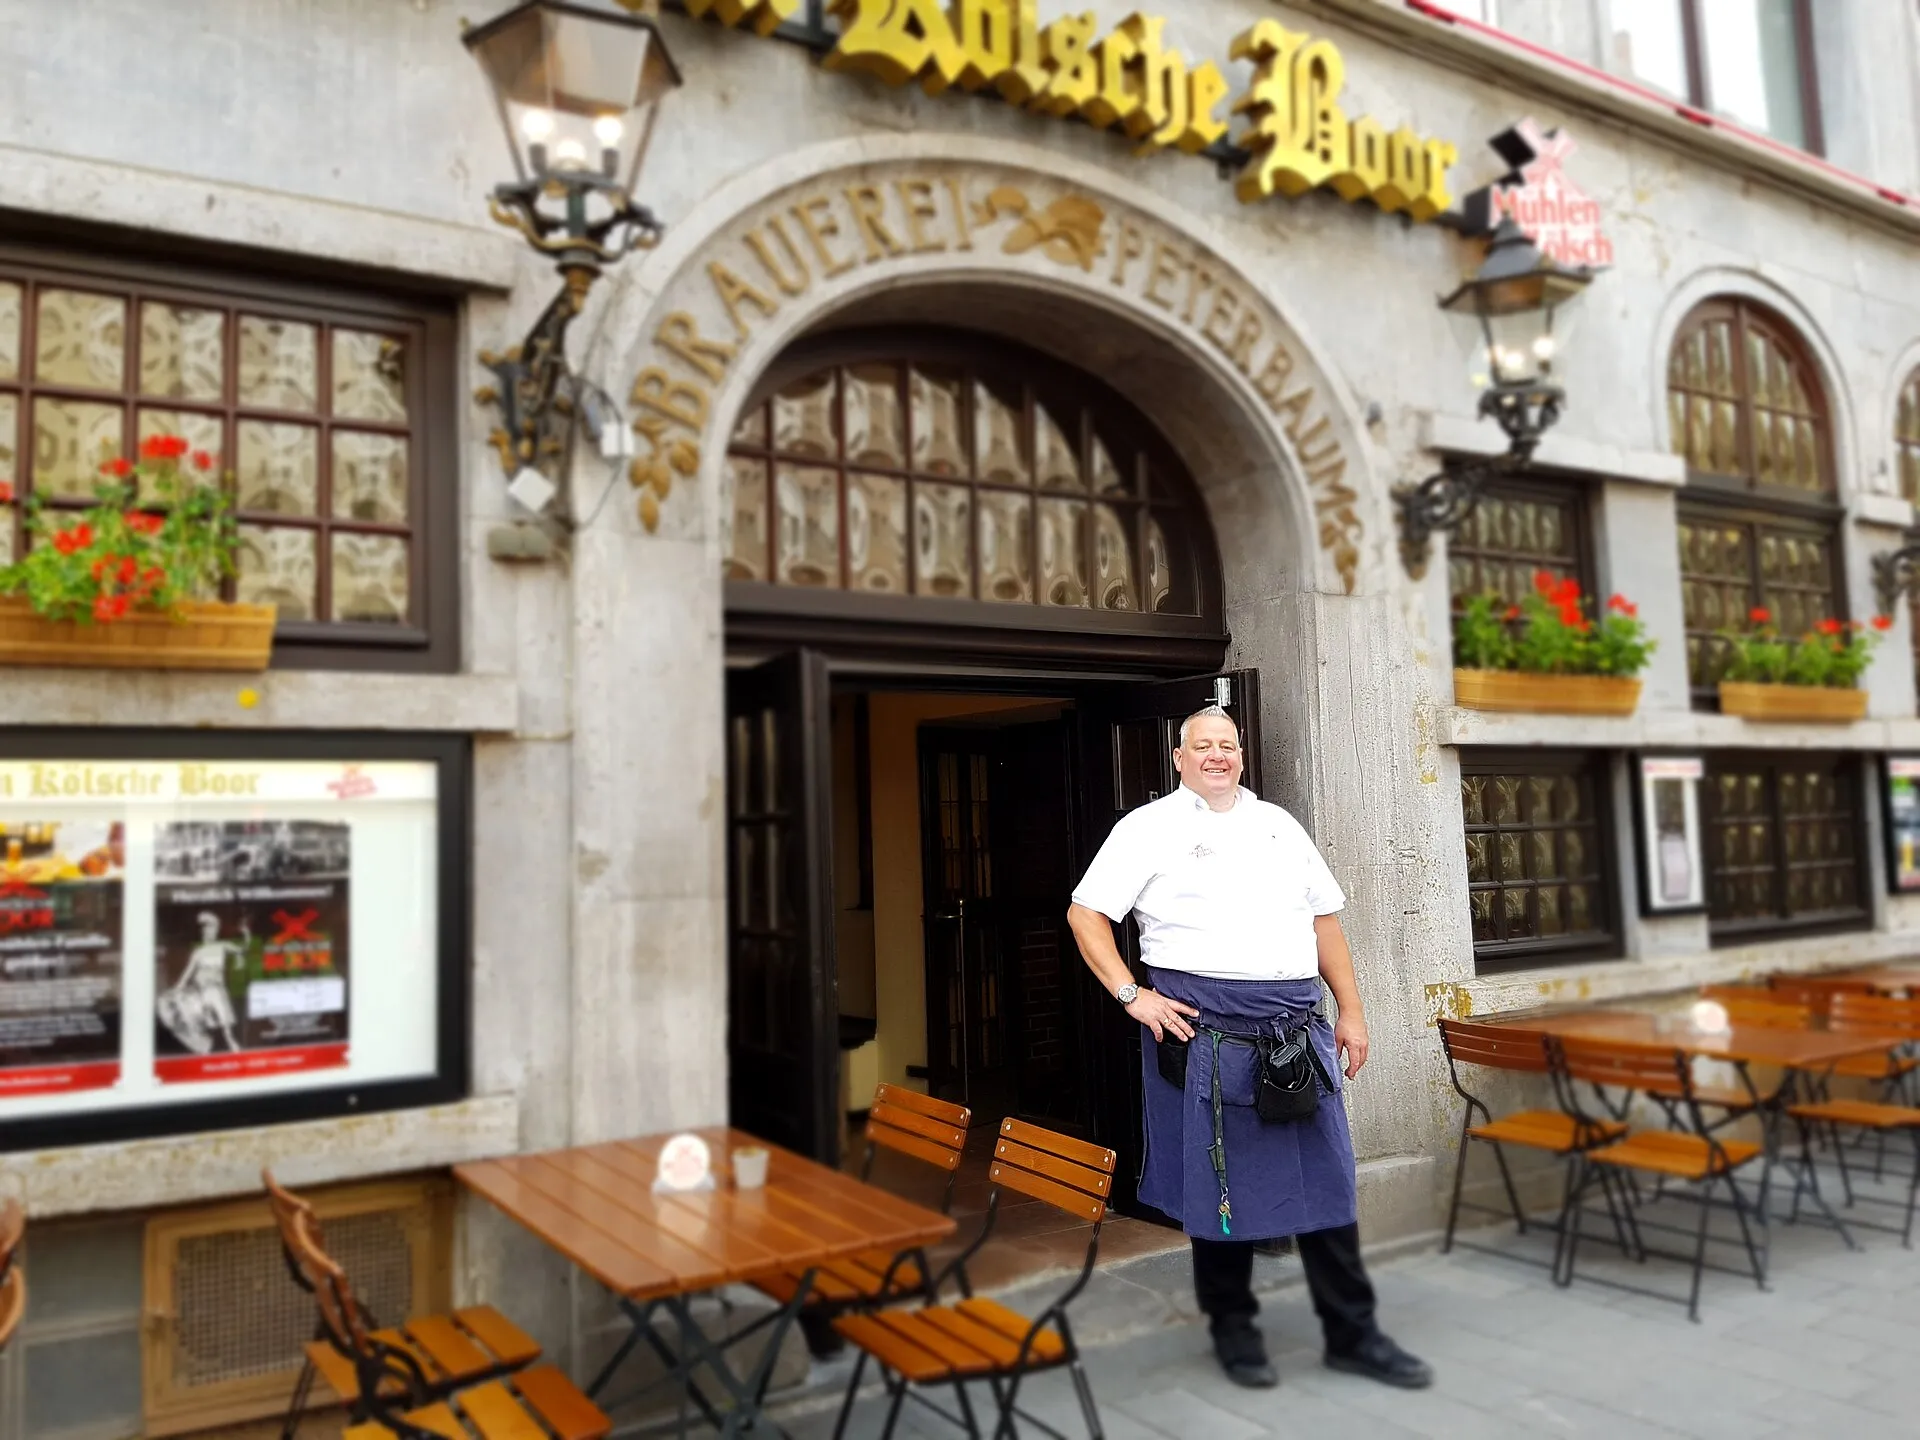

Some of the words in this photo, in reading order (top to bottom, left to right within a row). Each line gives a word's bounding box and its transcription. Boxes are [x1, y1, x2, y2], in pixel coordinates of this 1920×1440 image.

[1236, 17, 1458, 214] Boor
[628, 178, 974, 430] BRAUEREI
[1108, 208, 1264, 376] PETER
[1525, 228, 1614, 265] ölsch
